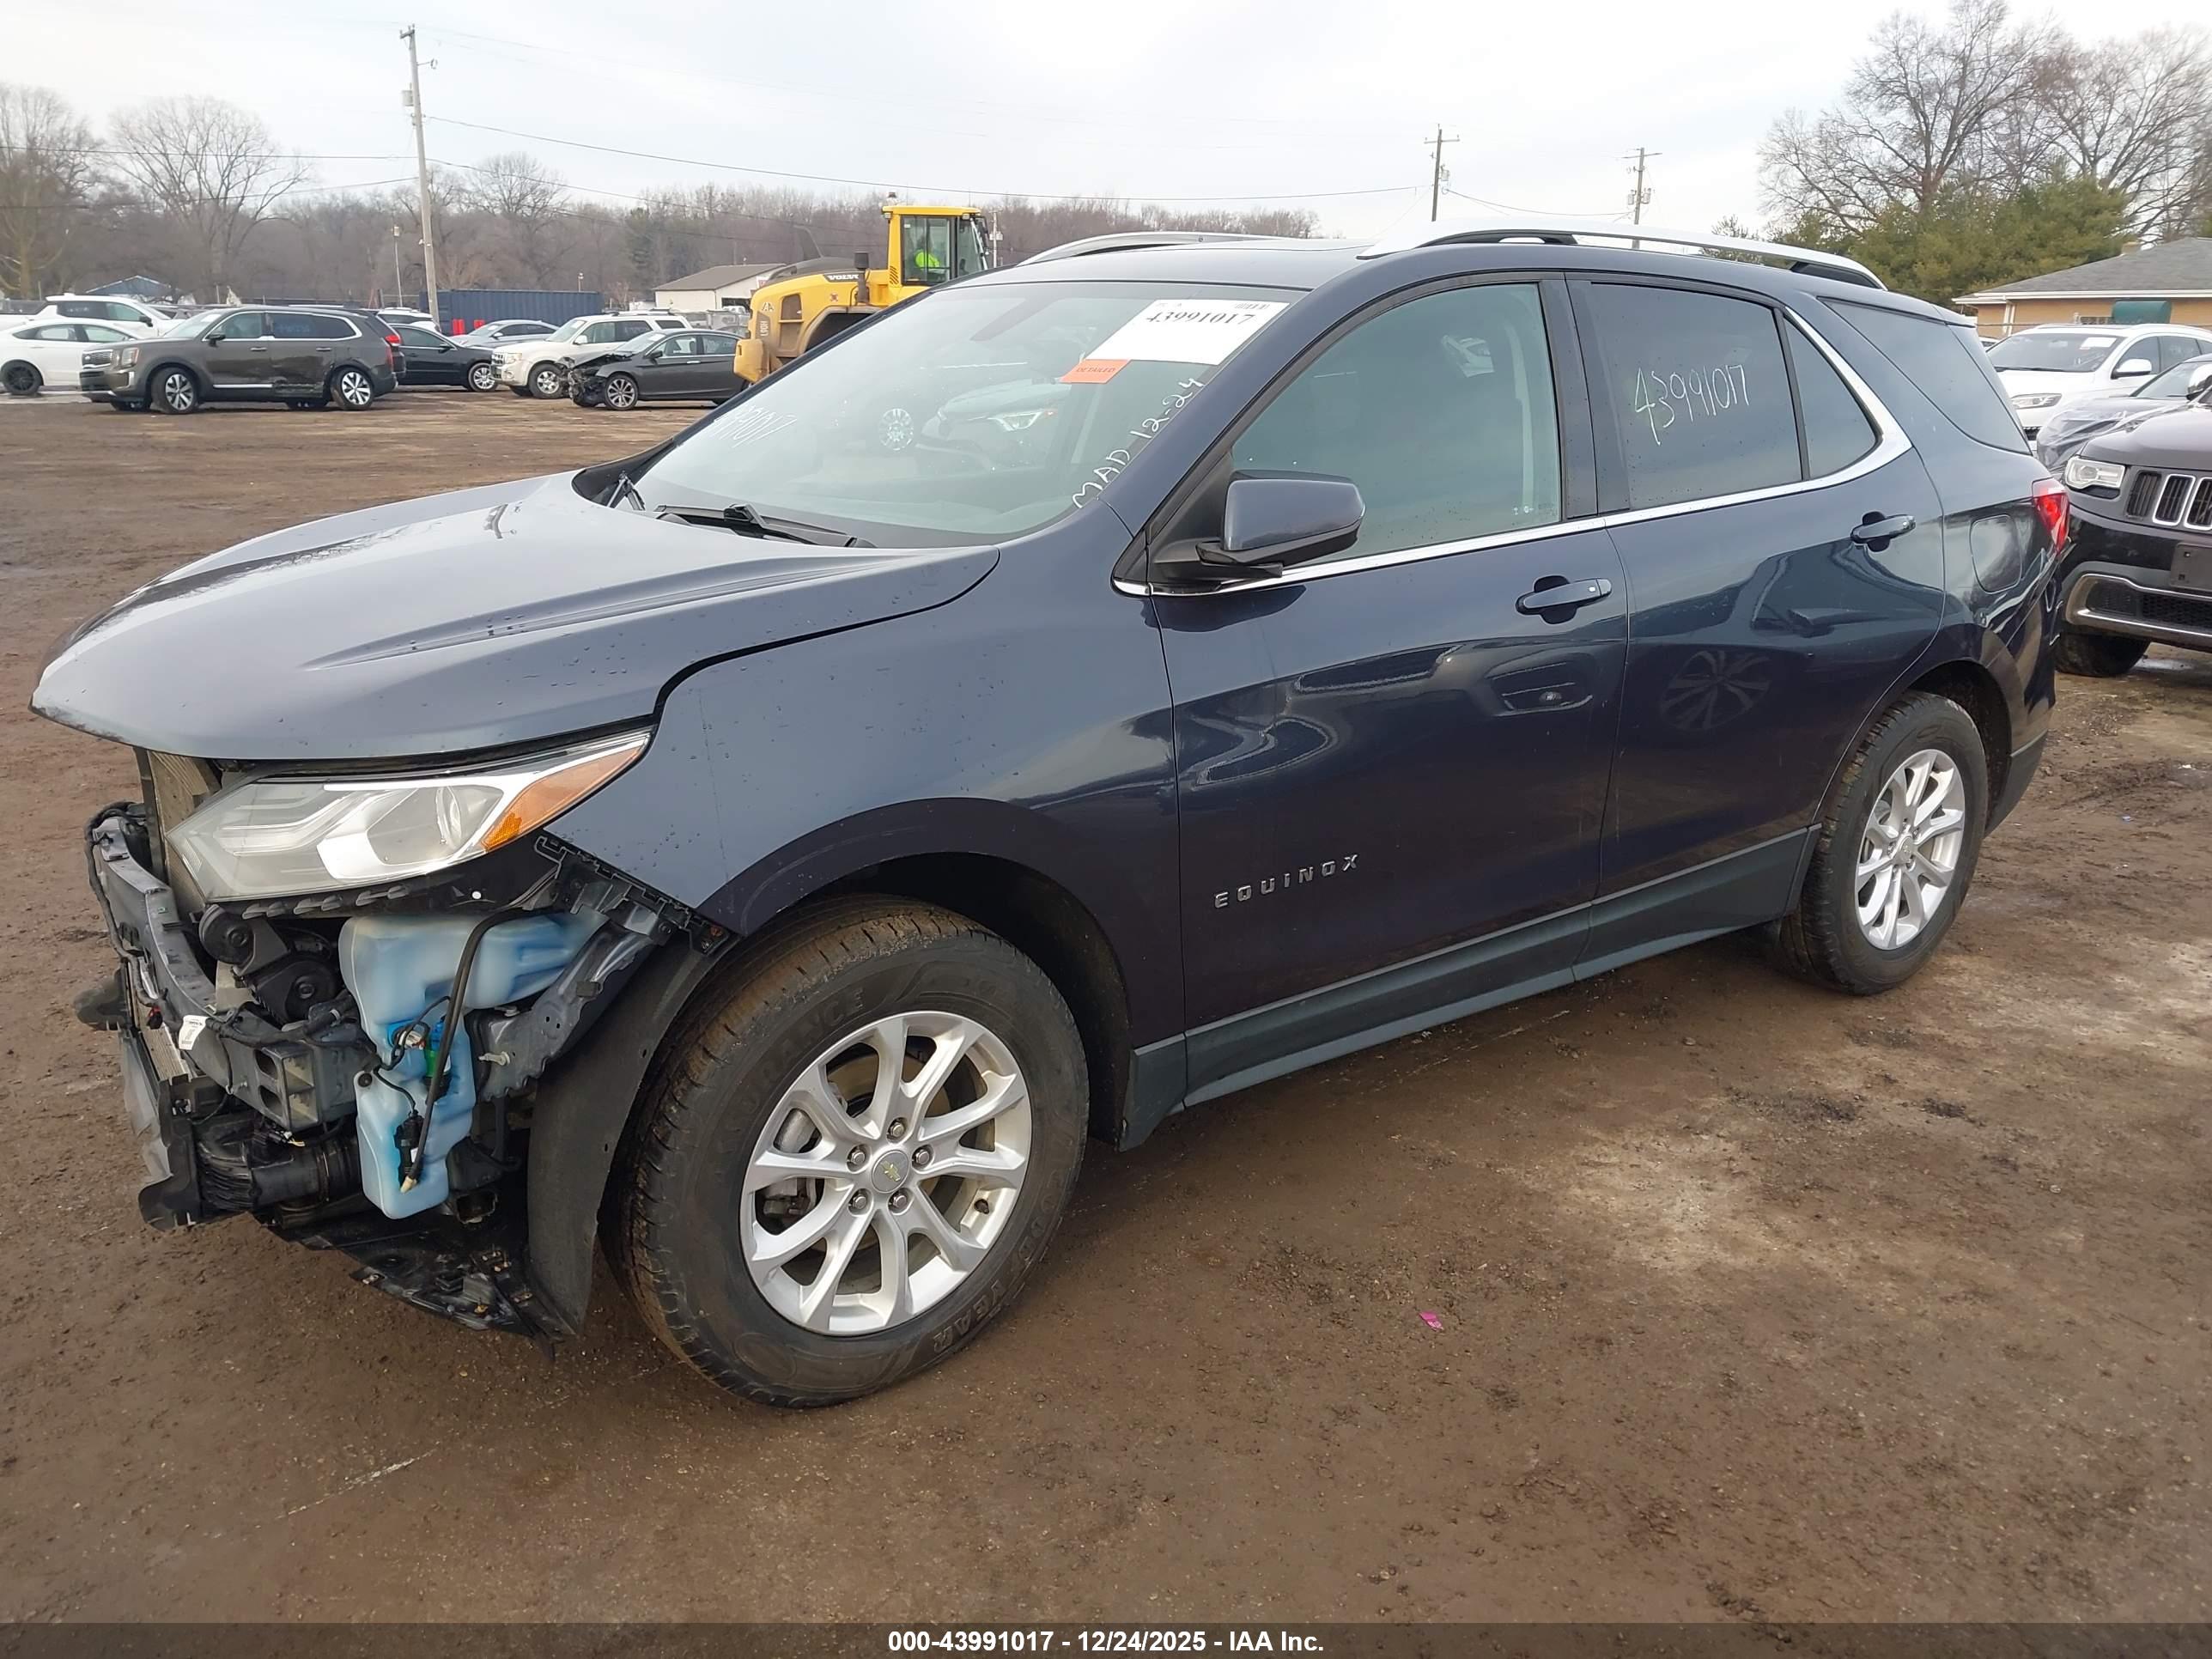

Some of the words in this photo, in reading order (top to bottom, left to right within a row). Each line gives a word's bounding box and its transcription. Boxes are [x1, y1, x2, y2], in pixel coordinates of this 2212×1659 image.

[1146, 311, 1257, 325] 43991017
[1633, 363, 1750, 447] 43991017
[1072, 448, 1131, 509] MAD
[1129, 377, 1206, 439] 12-24
[1213, 853, 1359, 909] EQUINOX
